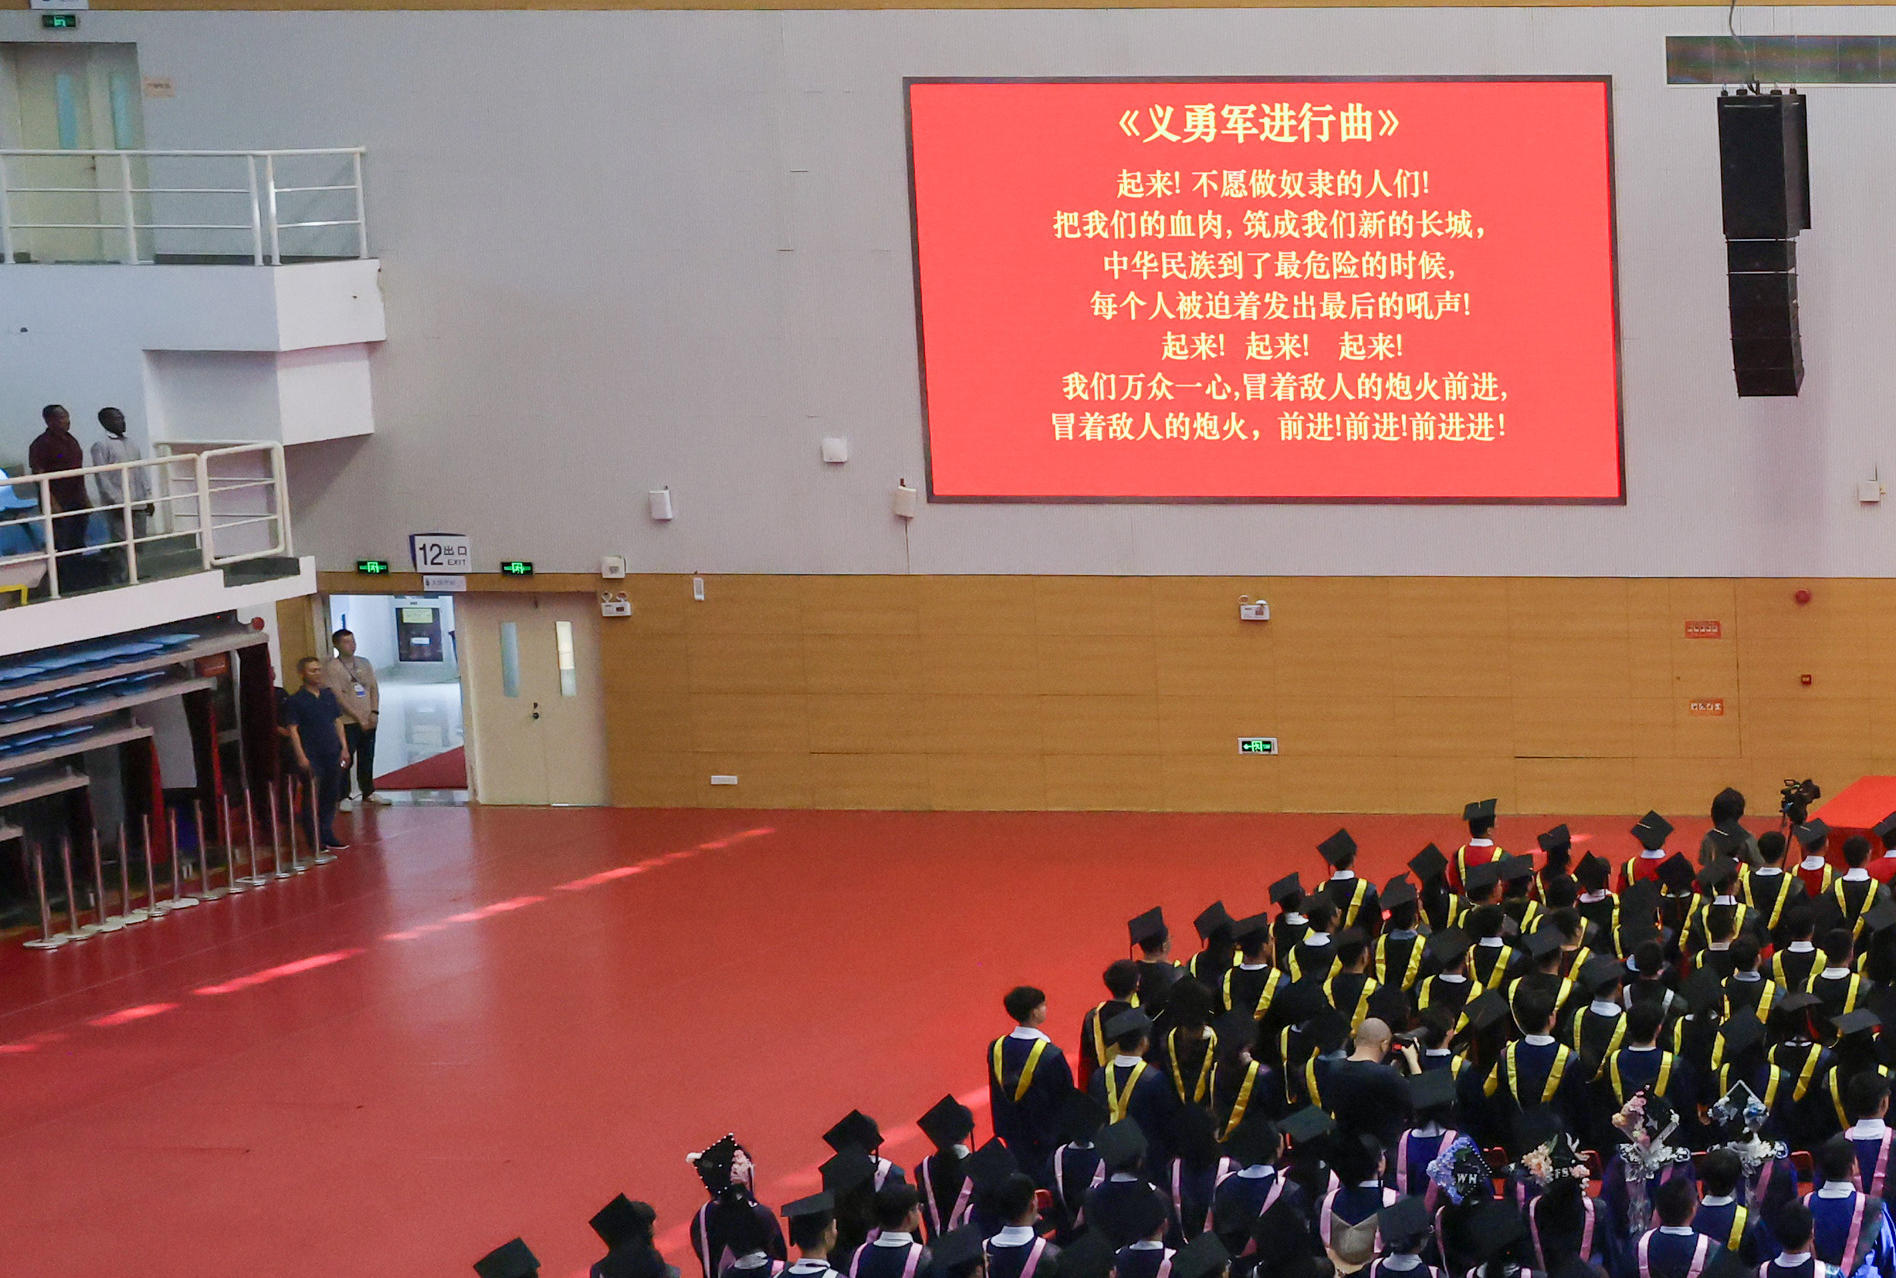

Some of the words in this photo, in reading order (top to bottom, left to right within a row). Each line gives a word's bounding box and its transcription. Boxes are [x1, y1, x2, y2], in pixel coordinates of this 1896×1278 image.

[1118, 102, 1401, 144] 《义勇军进行曲》
[1191, 168, 1430, 200] 不愿做奴隶的人们!
[1090, 290, 1472, 321] 每个人被迫着发出最后的吼声!
[1161, 330, 1226, 361] 起来!
[1245, 330, 1310, 361] 起来!
[1338, 330, 1404, 361] 起来!
[418, 543, 443, 566] 12
[444, 545, 467, 556] 出口
[447, 558, 466, 566] EXIT
